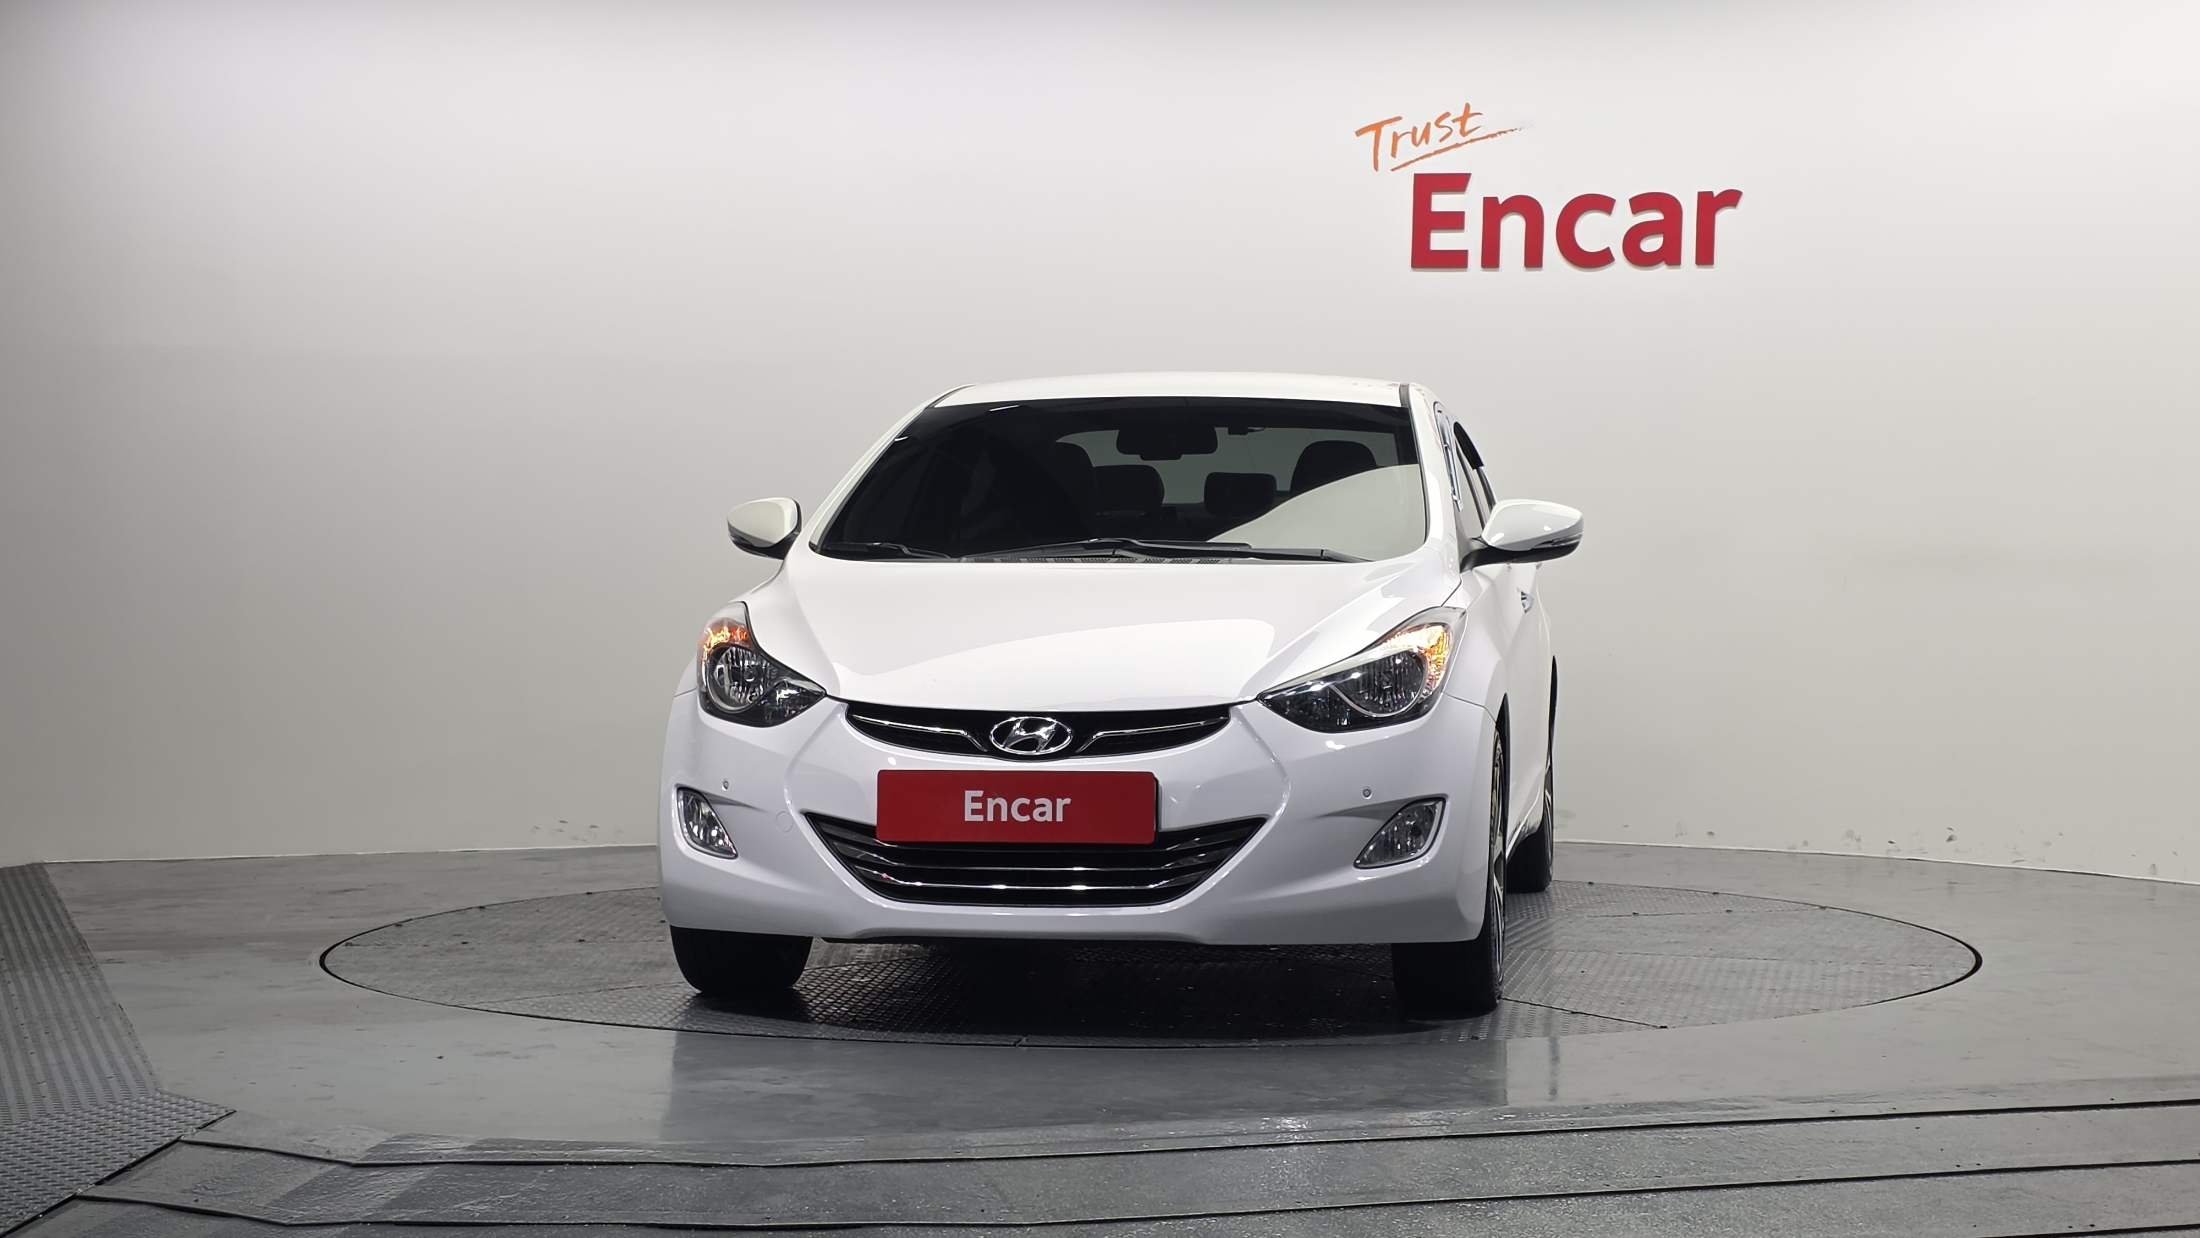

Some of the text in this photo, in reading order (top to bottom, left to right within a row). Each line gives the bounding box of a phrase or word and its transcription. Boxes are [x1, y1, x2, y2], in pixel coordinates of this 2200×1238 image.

[1355, 102, 1484, 171] Trust
[1411, 172, 1743, 269] Encar
[963, 789, 1072, 823] Encar
